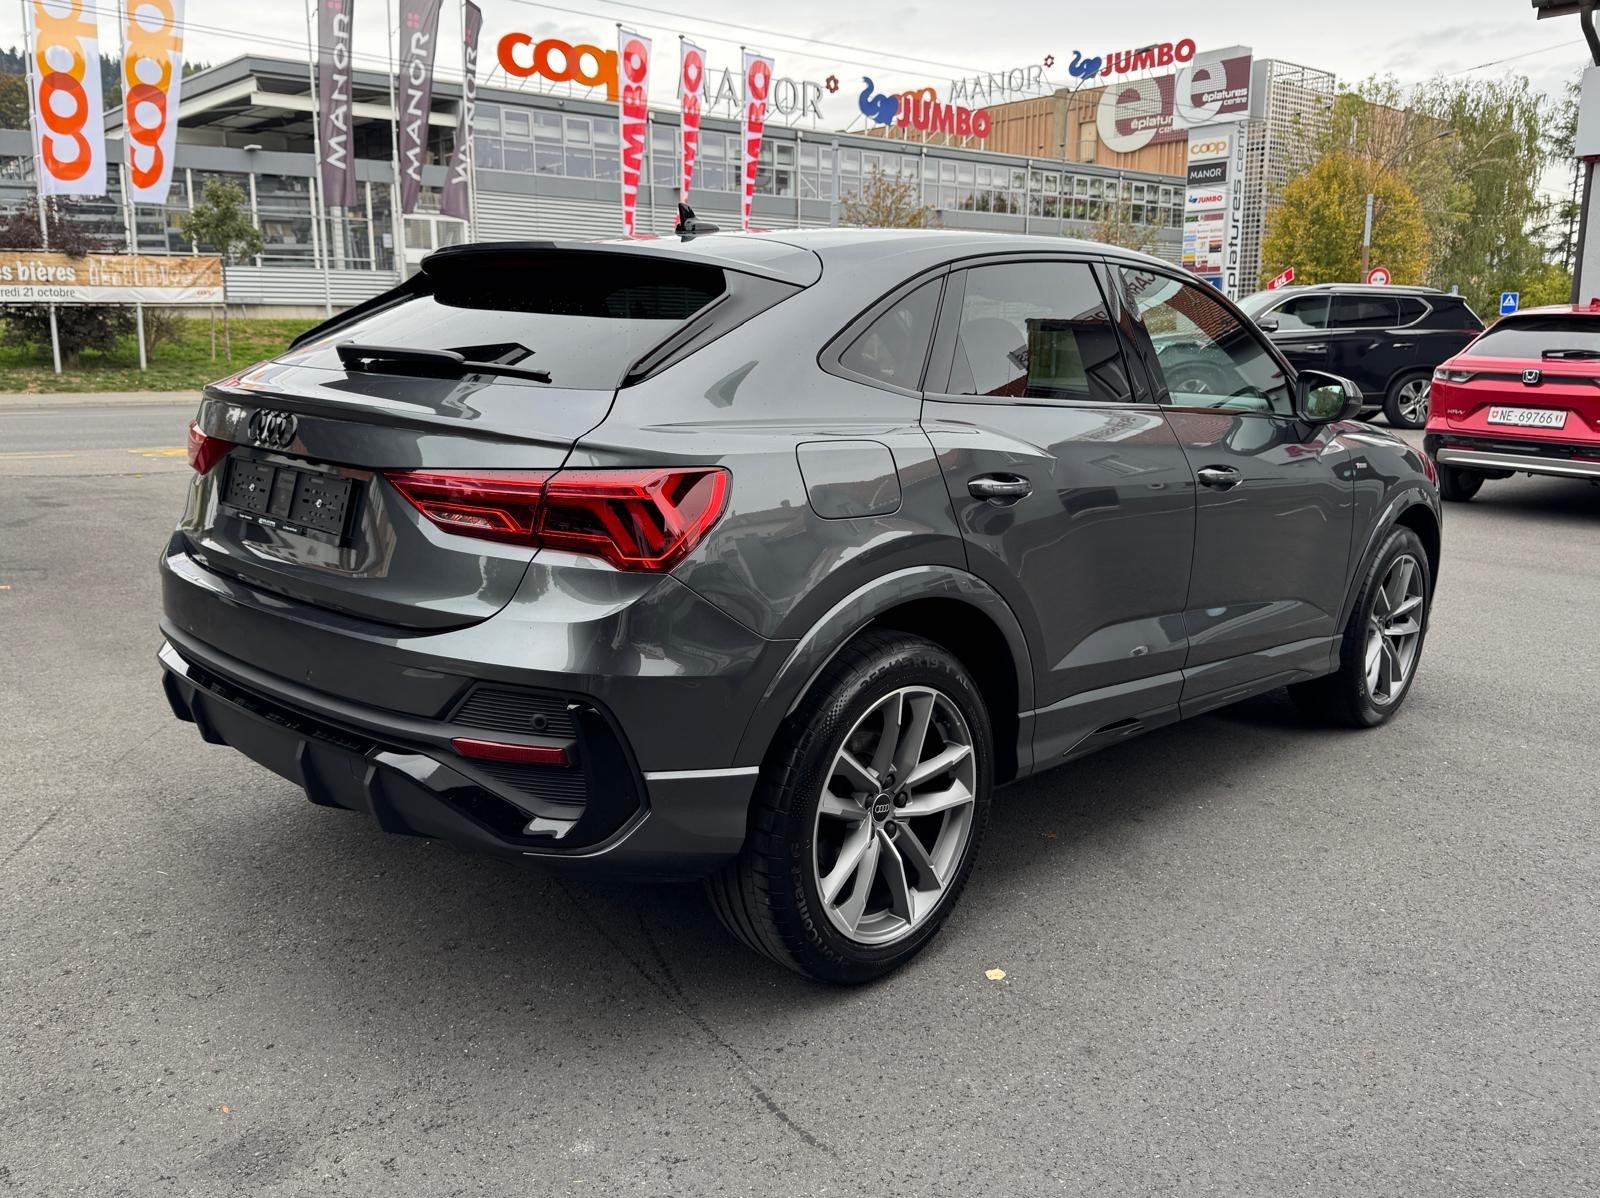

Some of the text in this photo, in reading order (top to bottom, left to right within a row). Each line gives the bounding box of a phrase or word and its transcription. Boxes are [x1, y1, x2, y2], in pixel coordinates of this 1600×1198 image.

[1100, 38, 1196, 77] JUMBO
[34, 0, 98, 181] coop
[125, 0, 183, 189] coop
[326, 13, 349, 170] MANOR
[949, 65, 1043, 102] MANOR
[406, 32, 430, 181] MANOR
[896, 95, 992, 139] JUMBO
[1190, 141, 1227, 155] coop
[1189, 168, 1222, 180] MANOR
[1198, 195, 1223, 204] JUMBO
[16, 261, 76, 282] bières
[23, 287, 34, 297] 21
[37, 287, 76, 297] octobre
